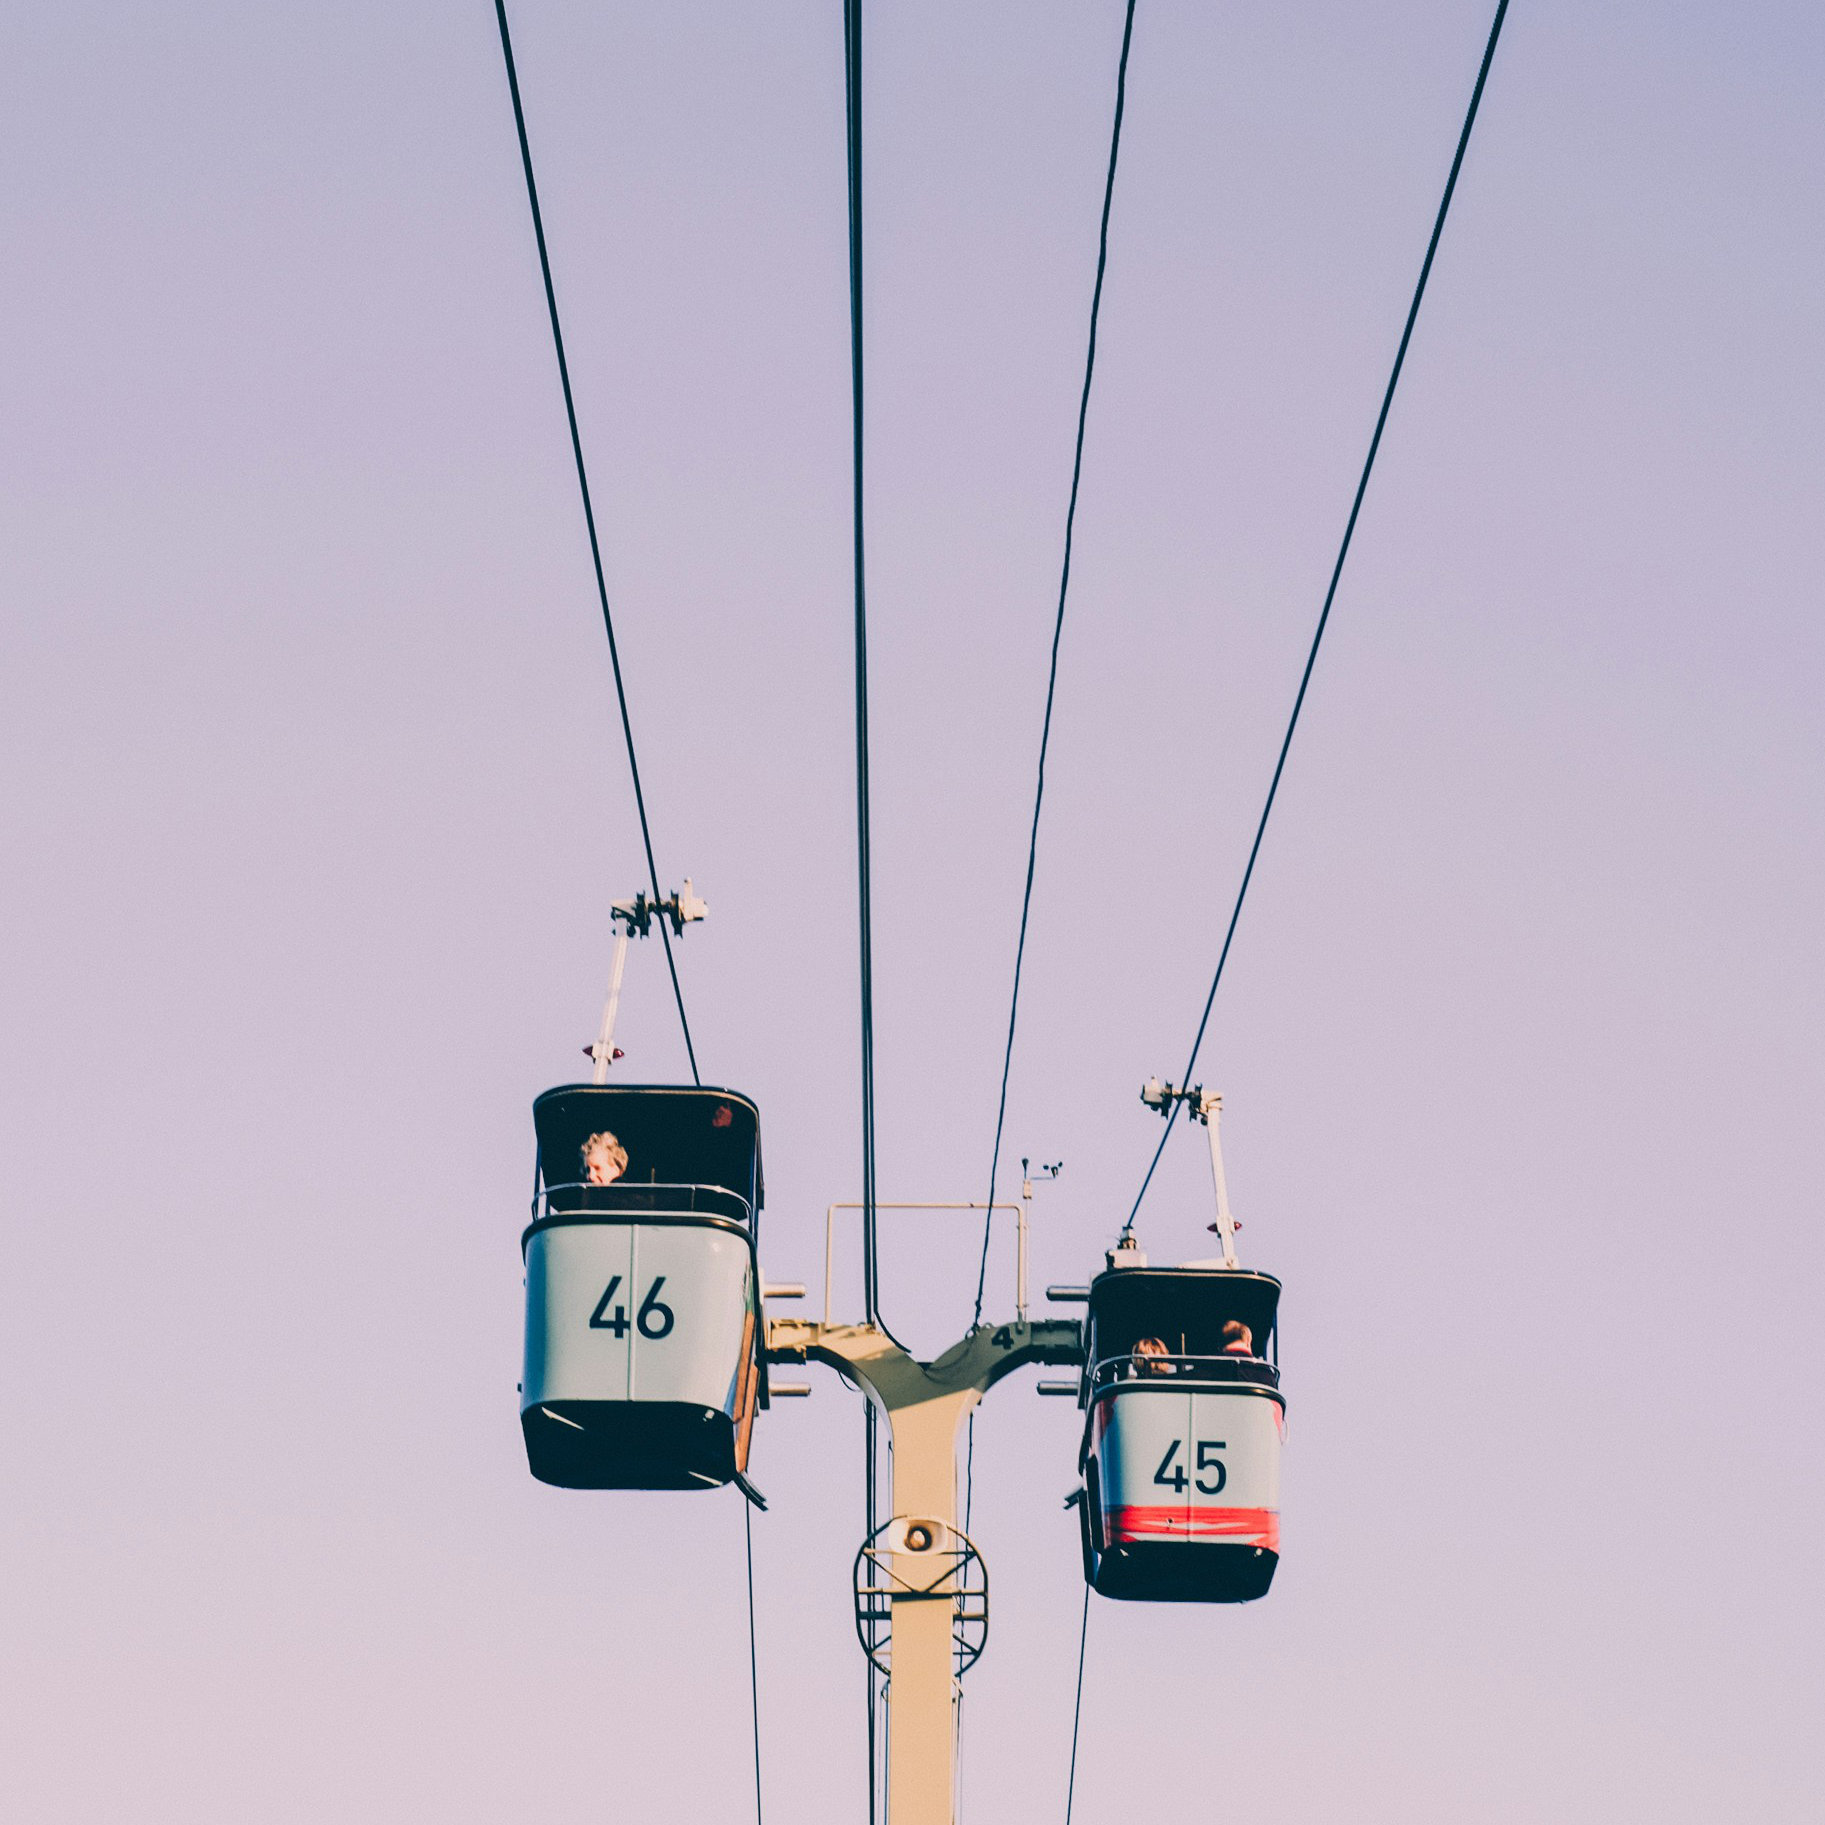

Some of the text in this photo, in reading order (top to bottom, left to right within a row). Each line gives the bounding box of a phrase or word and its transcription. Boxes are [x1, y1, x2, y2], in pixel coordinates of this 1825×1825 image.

[589, 1276, 675, 1340] 46
[991, 1326, 1015, 1350] 4
[1154, 1439, 1227, 1495] 45
